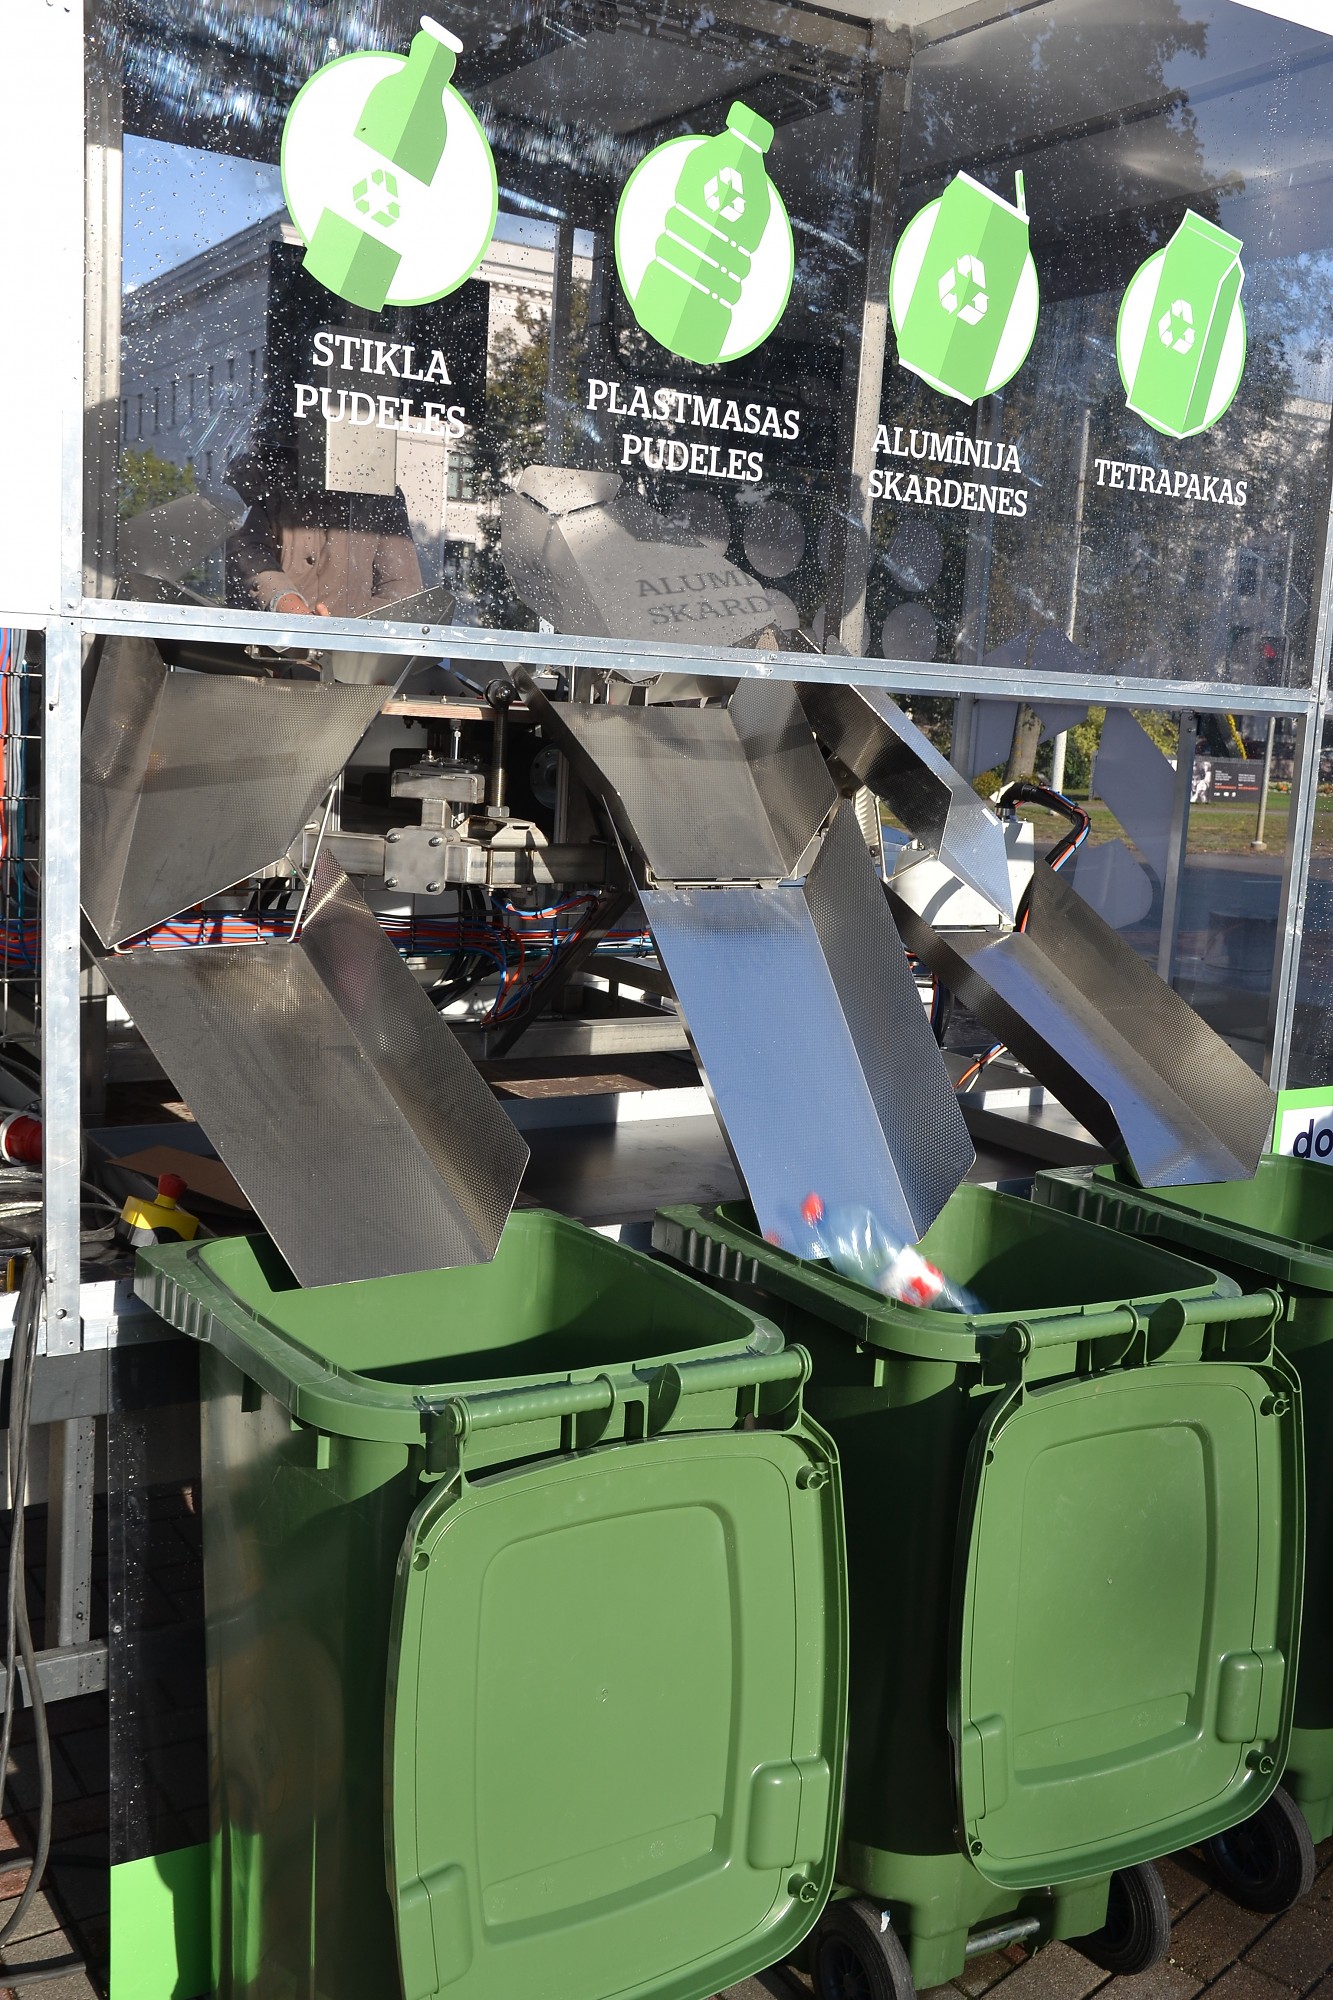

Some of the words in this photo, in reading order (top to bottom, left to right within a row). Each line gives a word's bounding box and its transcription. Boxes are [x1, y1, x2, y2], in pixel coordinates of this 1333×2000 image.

[312, 332, 452, 385] STIKLA
[293, 383, 466, 439] PUDELES
[586, 378, 800, 440] PLASTMASAS
[620, 433, 764, 482] PUDELES
[870, 424, 1022, 474] ALUMĪNIJA
[867, 469, 1028, 518] SKARDENES
[1094, 458, 1248, 506] TETRAPAKAS
